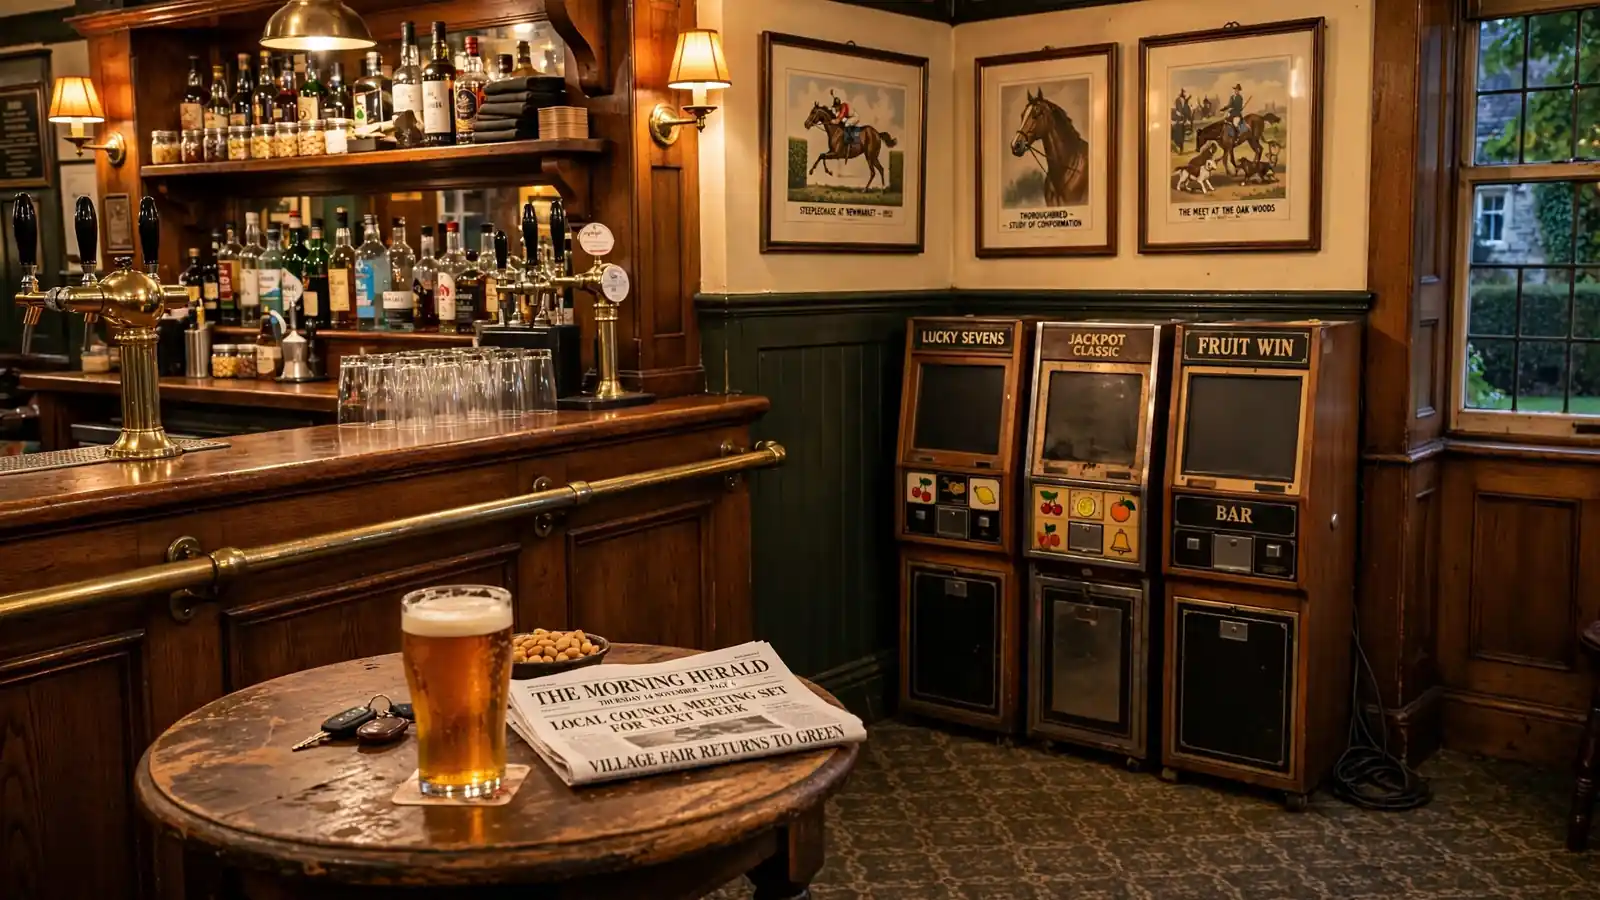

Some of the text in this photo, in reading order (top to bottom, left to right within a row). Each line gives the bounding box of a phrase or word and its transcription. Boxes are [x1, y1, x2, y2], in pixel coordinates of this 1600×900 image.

[800, 206, 836, 216] STEEPLECHASE
[838, 207, 844, 216] AT
[1020, 210, 1068, 220] THOROUGHBRED
[1178, 204, 1275, 216] THE MEET AT THE OAK WOODS
[1009, 221, 1027, 229] STUDY
[1028, 220, 1036, 229] OF
[1037, 219, 1082, 229] CONFORMATION
[922, 330, 1005, 345] LUCKY SEVENS
[1067, 332, 1126, 346] JACKPOT
[1073, 345, 1120, 357] CLASSIC
[1197, 337, 1294, 357] FRUIT WIN
[1215, 505, 1254, 524] BAR
[531, 659, 770, 706] THE MORNING HERALD
[598, 694, 641, 706] THURSDAY
[654, 687, 700, 698] NOVEMBER
[549, 712, 607, 731] LOCAL
[609, 703, 680, 723] COUNCIL
[683, 691, 757, 713] MEETING
[757, 685, 788, 698] SET
[610, 718, 649, 734] FOR
[650, 710, 695, 728] NEXT
[697, 703, 749, 721] WEEK
[588, 723, 846, 774] VILLAGE FAIR RETURNS TO GREEN
